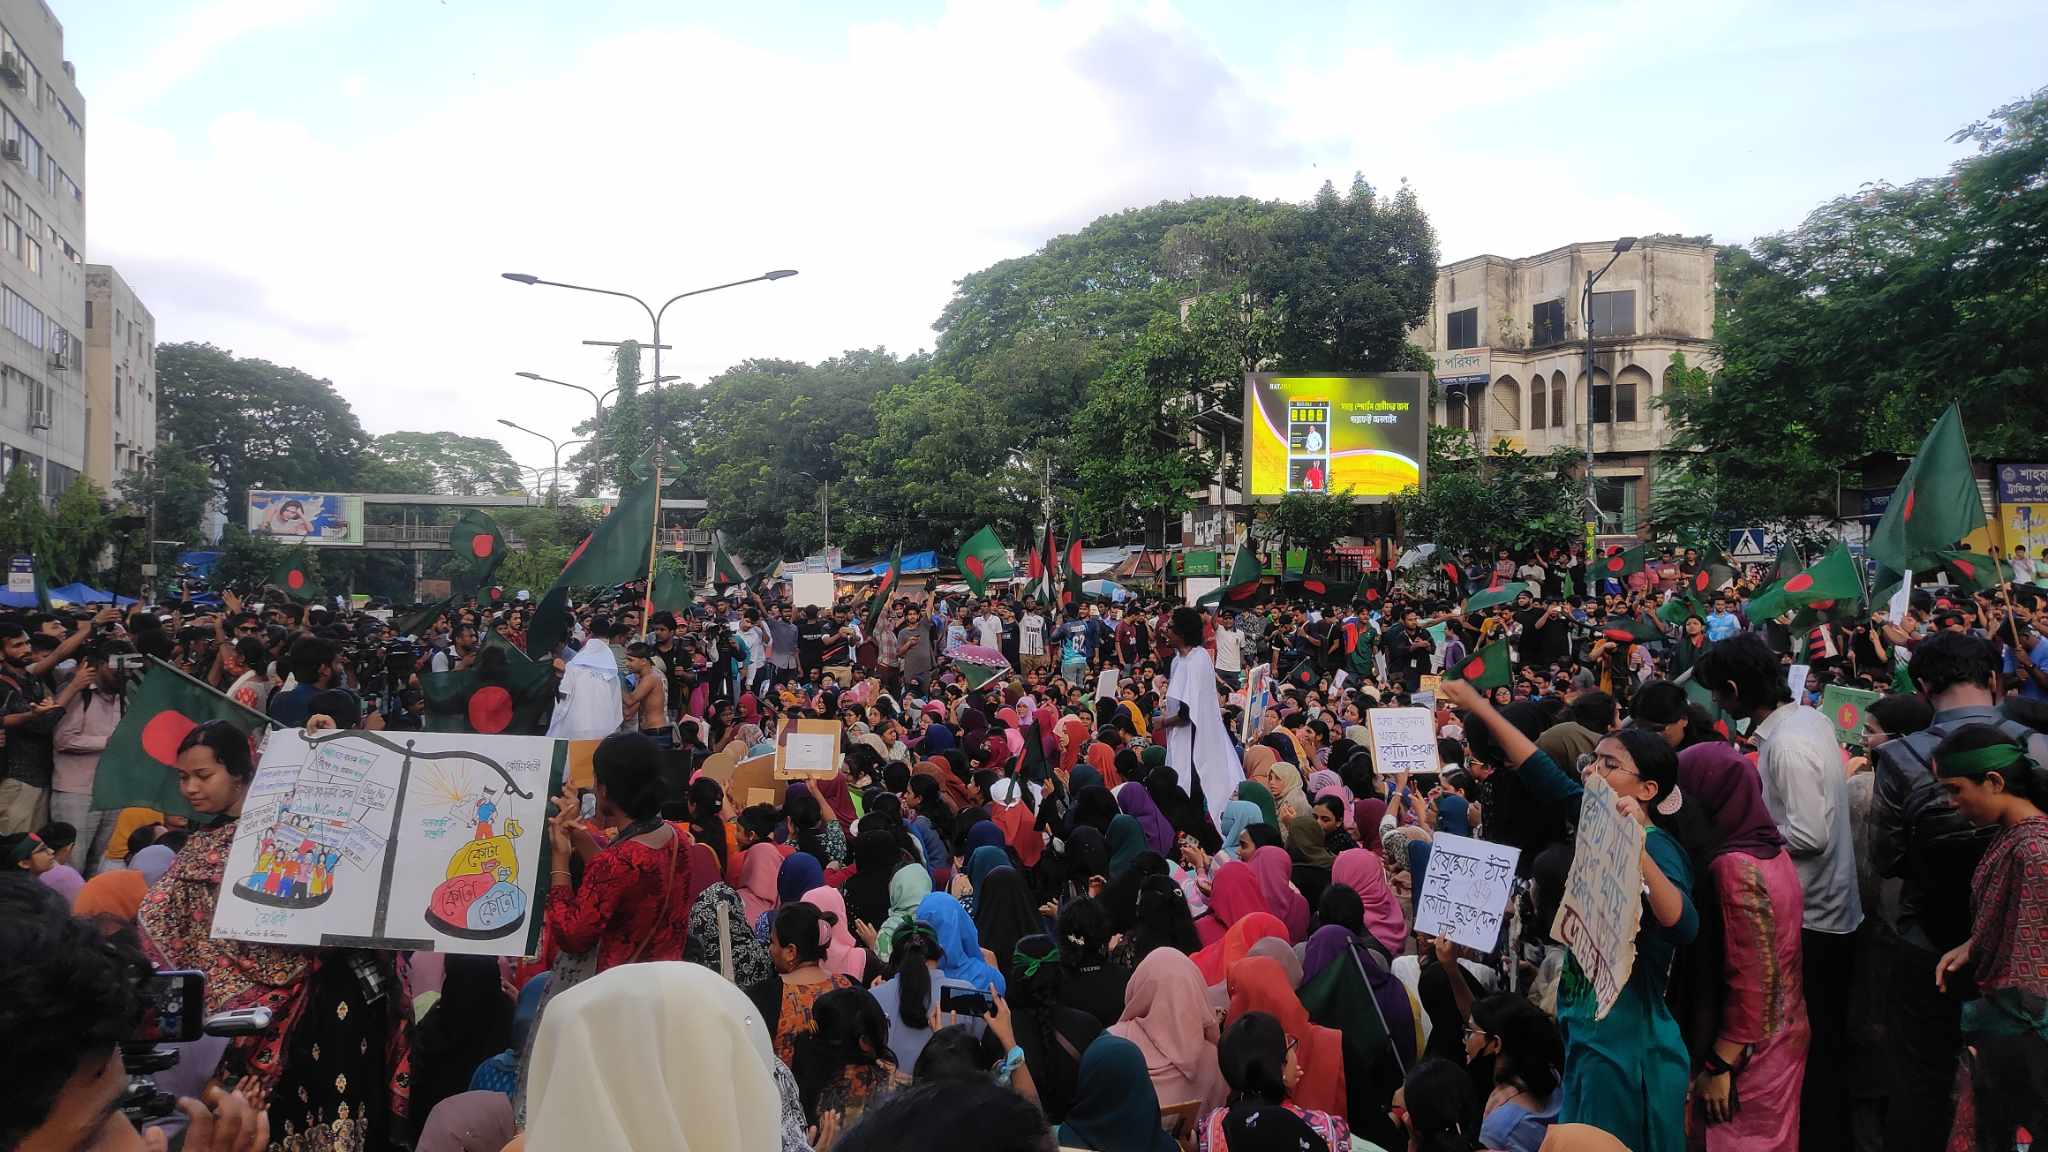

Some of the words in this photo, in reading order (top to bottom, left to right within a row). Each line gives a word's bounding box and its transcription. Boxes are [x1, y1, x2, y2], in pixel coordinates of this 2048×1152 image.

[468, 842, 501, 868] কোটা
[442, 880, 478, 916] কোটা
[479, 889, 516, 926] কোটা
[1423, 894, 1451, 920] কোটা
